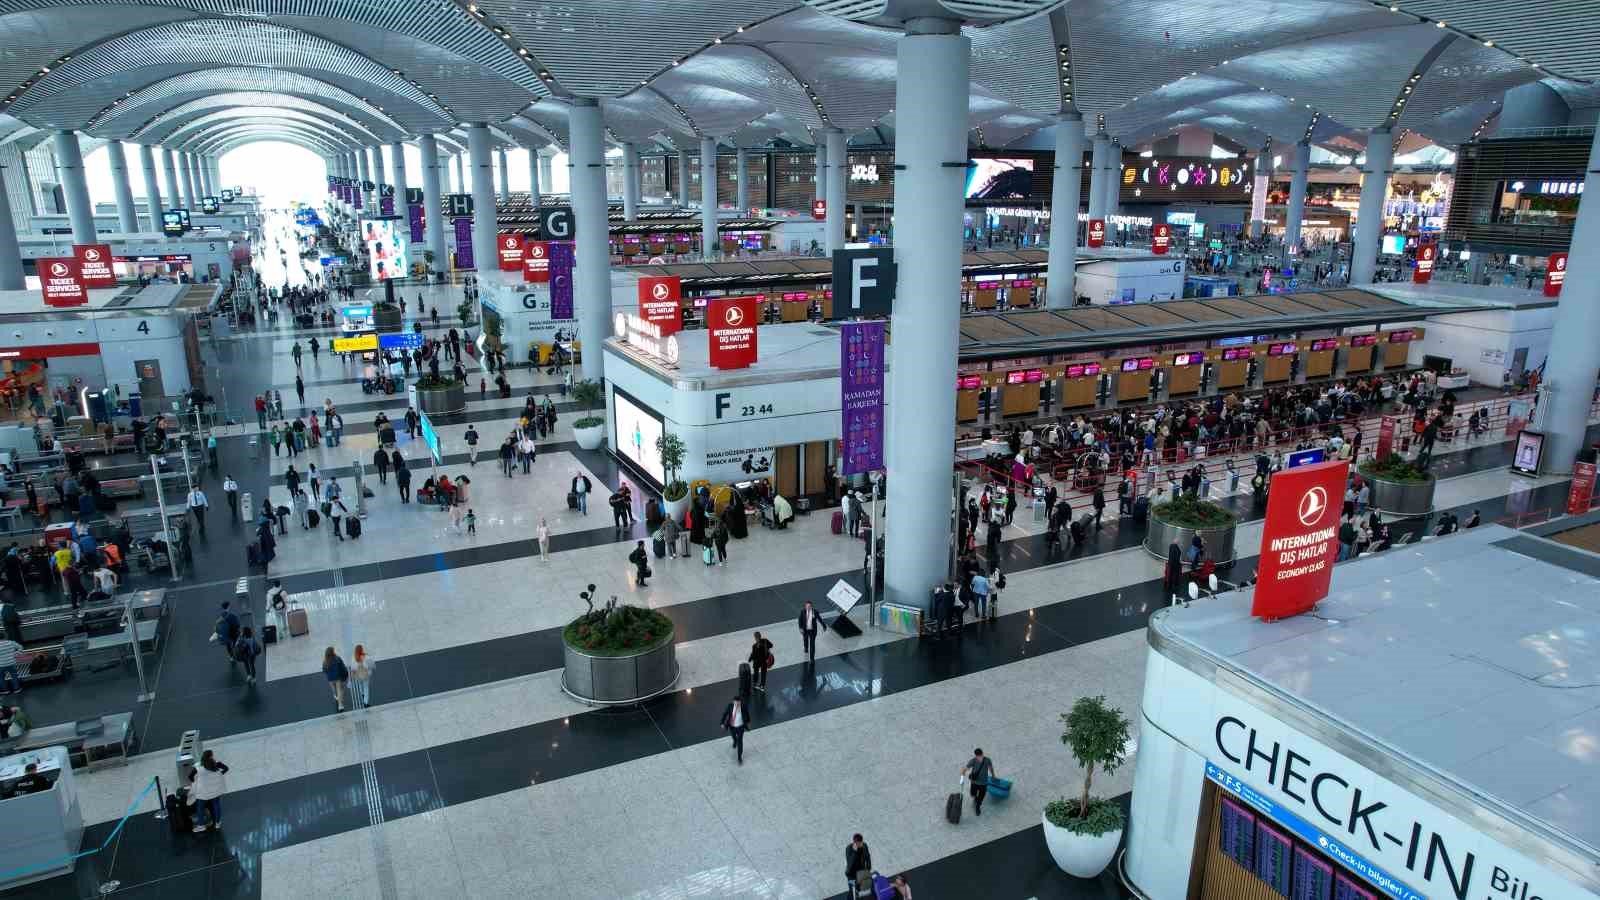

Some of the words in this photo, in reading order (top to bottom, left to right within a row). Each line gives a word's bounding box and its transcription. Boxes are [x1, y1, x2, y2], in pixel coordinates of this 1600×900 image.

[382, 185, 391, 196] K
[410, 189, 418, 202] J
[1541, 182, 1584, 193] HUNGR
[454, 198, 468, 214] H
[546, 211, 568, 236] G
[1110, 214, 1153, 226] DEPARTURES
[1173, 261, 1181, 272] G
[852, 257, 878, 308] F
[523, 294, 536, 309] G
[137, 320, 150, 335] 4
[714, 328, 754, 336] INTERNATIONAL
[844, 389, 881, 400] RAMADAN
[715, 393, 730, 419] F
[1271, 526, 1336, 551] INTERNATIONAL
[1280, 551, 1296, 566] DIŞ
[1298, 542, 1328, 561] HATLAR
[1277, 566, 1308, 580] ECONOMY
[1308, 560, 1326, 573] CLASS
[1226, 775, 1242, 793] F-S
[1216, 716, 1475, 900] CHECK-IN
[1329, 843, 1366, 873] Check-in
[1368, 866, 1402, 896] bilgileri
